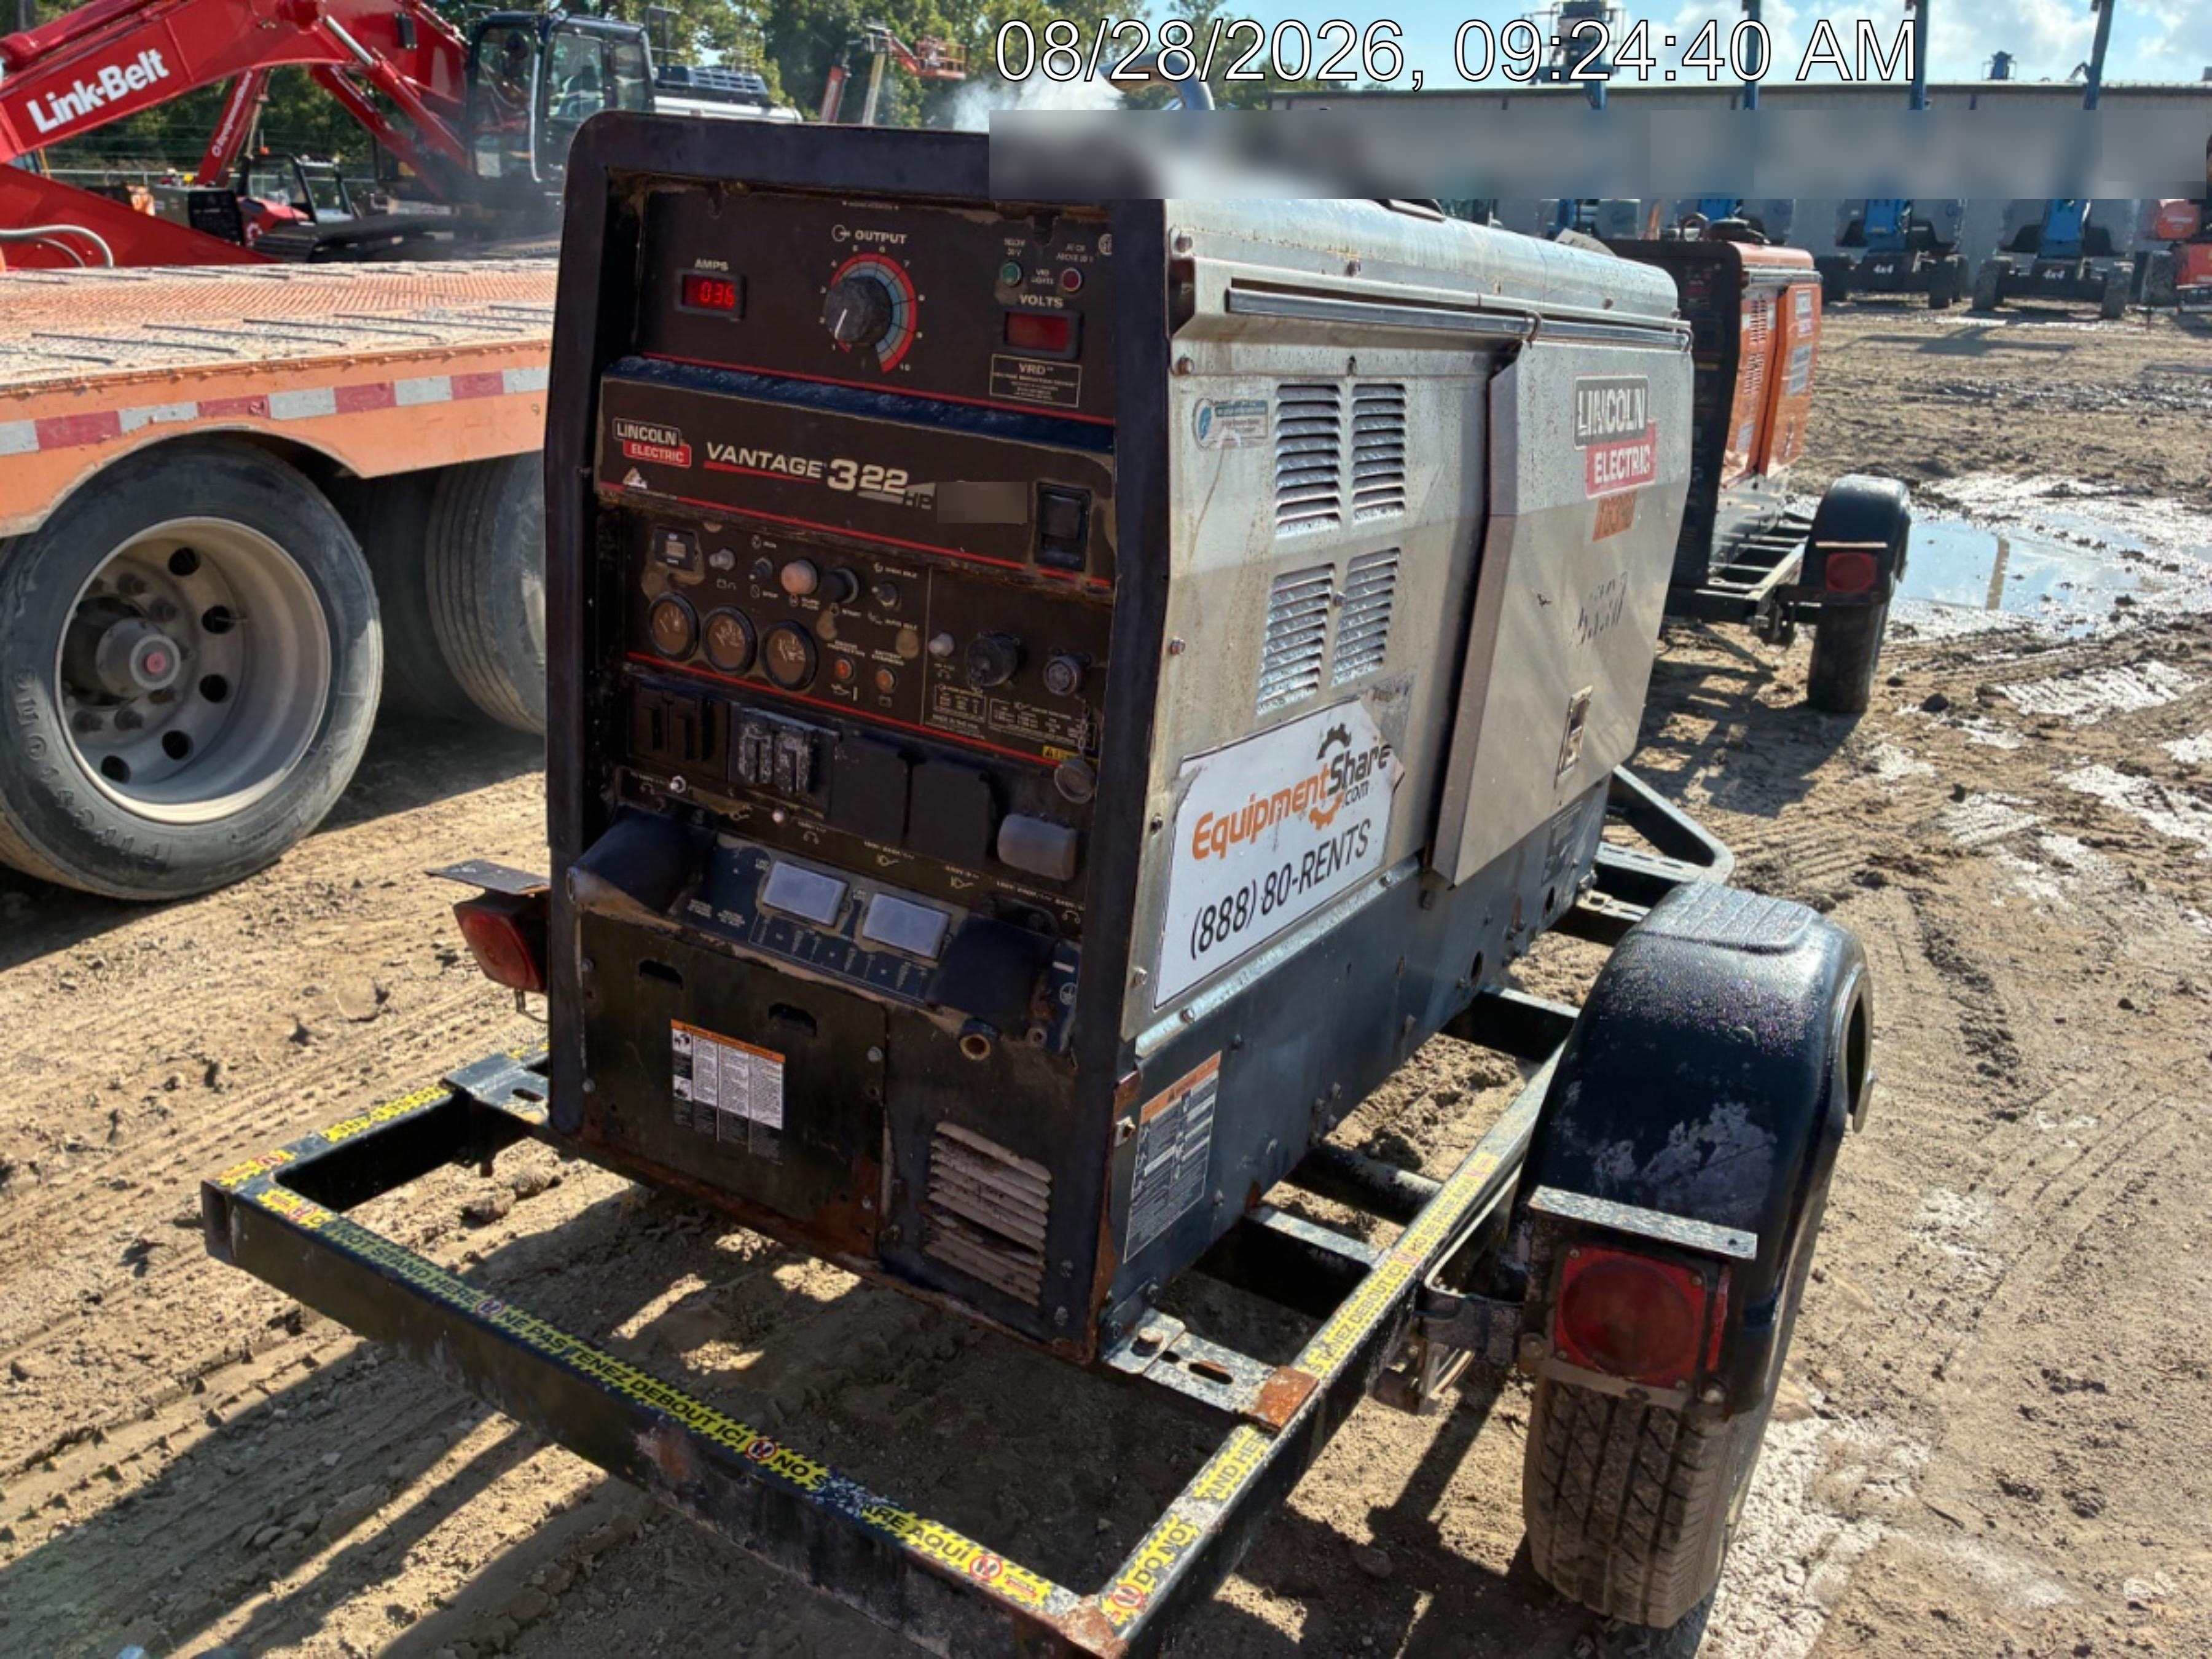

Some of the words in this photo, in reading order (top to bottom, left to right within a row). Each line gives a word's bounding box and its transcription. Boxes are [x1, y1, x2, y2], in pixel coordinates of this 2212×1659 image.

[26, 49, 170, 133] Link-Belt
[855, 230, 908, 245] OUTPUT
[694, 258, 729, 272] AMPS
[1873, 264, 1894, 274] 4x4
[2044, 270, 2065, 280] 4x4
[699, 281, 735, 306] 036
[1019, 294, 1064, 308] VOLTS
[1577, 388, 1645, 436] LINCOLN
[616, 422, 677, 445] LINCOLN
[631, 444, 684, 463] ELECTRIC
[1593, 444, 1651, 485] ELECTRIC
[707, 442, 823, 479] VANTAGE
[827, 458, 908, 495] 322
[1192, 744, 1392, 860] EquipmentShare
[1190, 879, 1257, 960] (888)
[1261, 818, 1371, 916] 80-RENTS
[371, 1245, 431, 1277] STAND
[432, 1274, 481, 1305] HERE
[1348, 1278, 1394, 1324] DEBOUT
[501, 1311, 529, 1328] NE
[526, 1325, 568, 1348] PAS
[630, 1380, 718, 1427] DEBOUT
[714, 1425, 749, 1445] ICI
[773, 1454, 810, 1477] NO
[1134, 1556, 1163, 1585] DO
